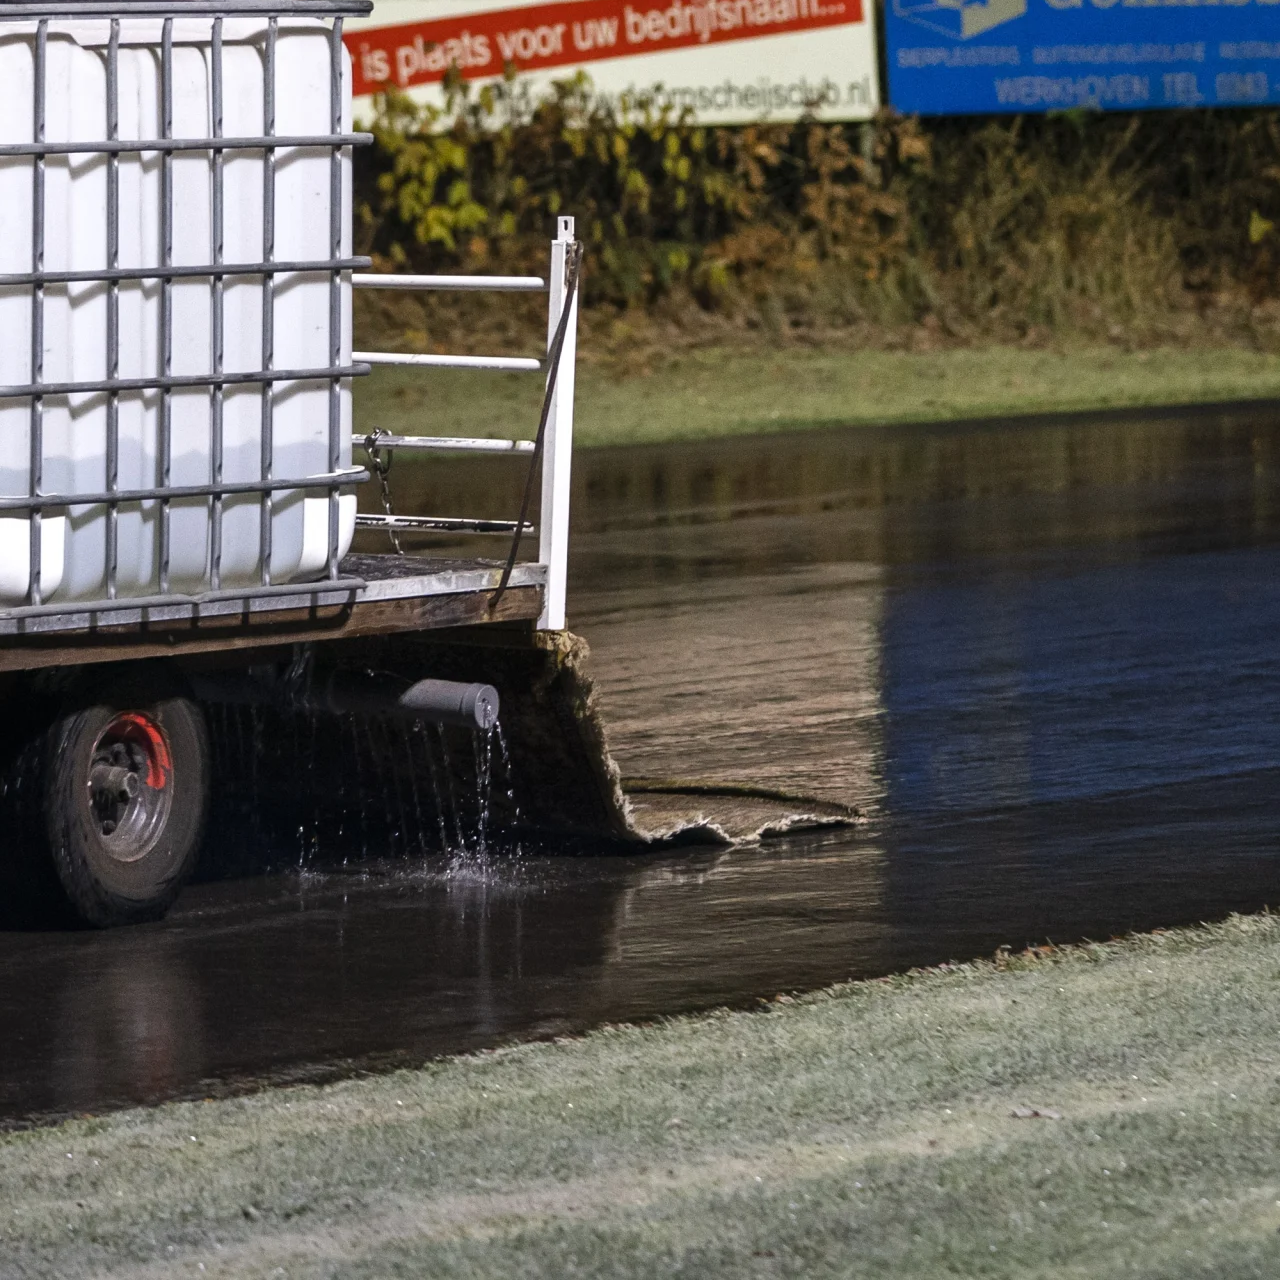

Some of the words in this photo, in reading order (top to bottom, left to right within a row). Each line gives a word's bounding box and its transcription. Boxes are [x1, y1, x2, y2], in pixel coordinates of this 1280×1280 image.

[360, 42, 391, 82] is
[396, 30, 492, 87] plaats
[496, 22, 567, 60] voor
[572, 15, 618, 52] uw
